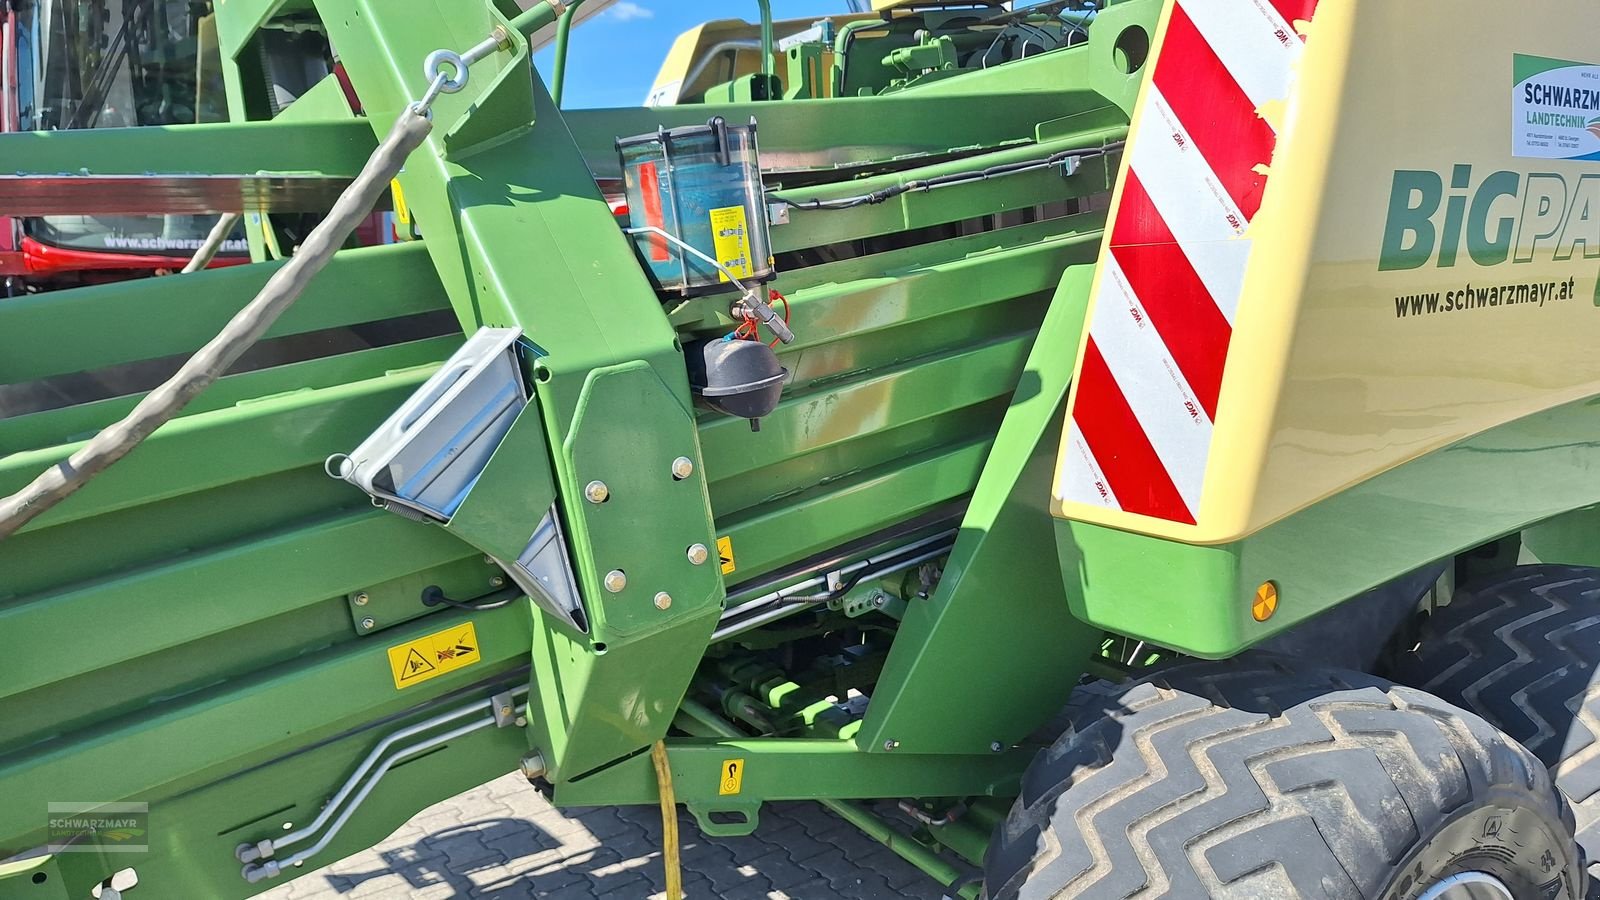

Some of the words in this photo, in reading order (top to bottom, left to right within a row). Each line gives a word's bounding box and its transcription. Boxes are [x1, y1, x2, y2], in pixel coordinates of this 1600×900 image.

[1274, 29, 1288, 44] WGF
[1525, 82, 1600, 111] SCHWARZM
[1526, 111, 1586, 128] LANDTECHNIK
[1395, 276, 1575, 318] www.schwarzmayr.at
[1184, 401, 1198, 418] WGF
[1095, 481, 1107, 498] WGF
